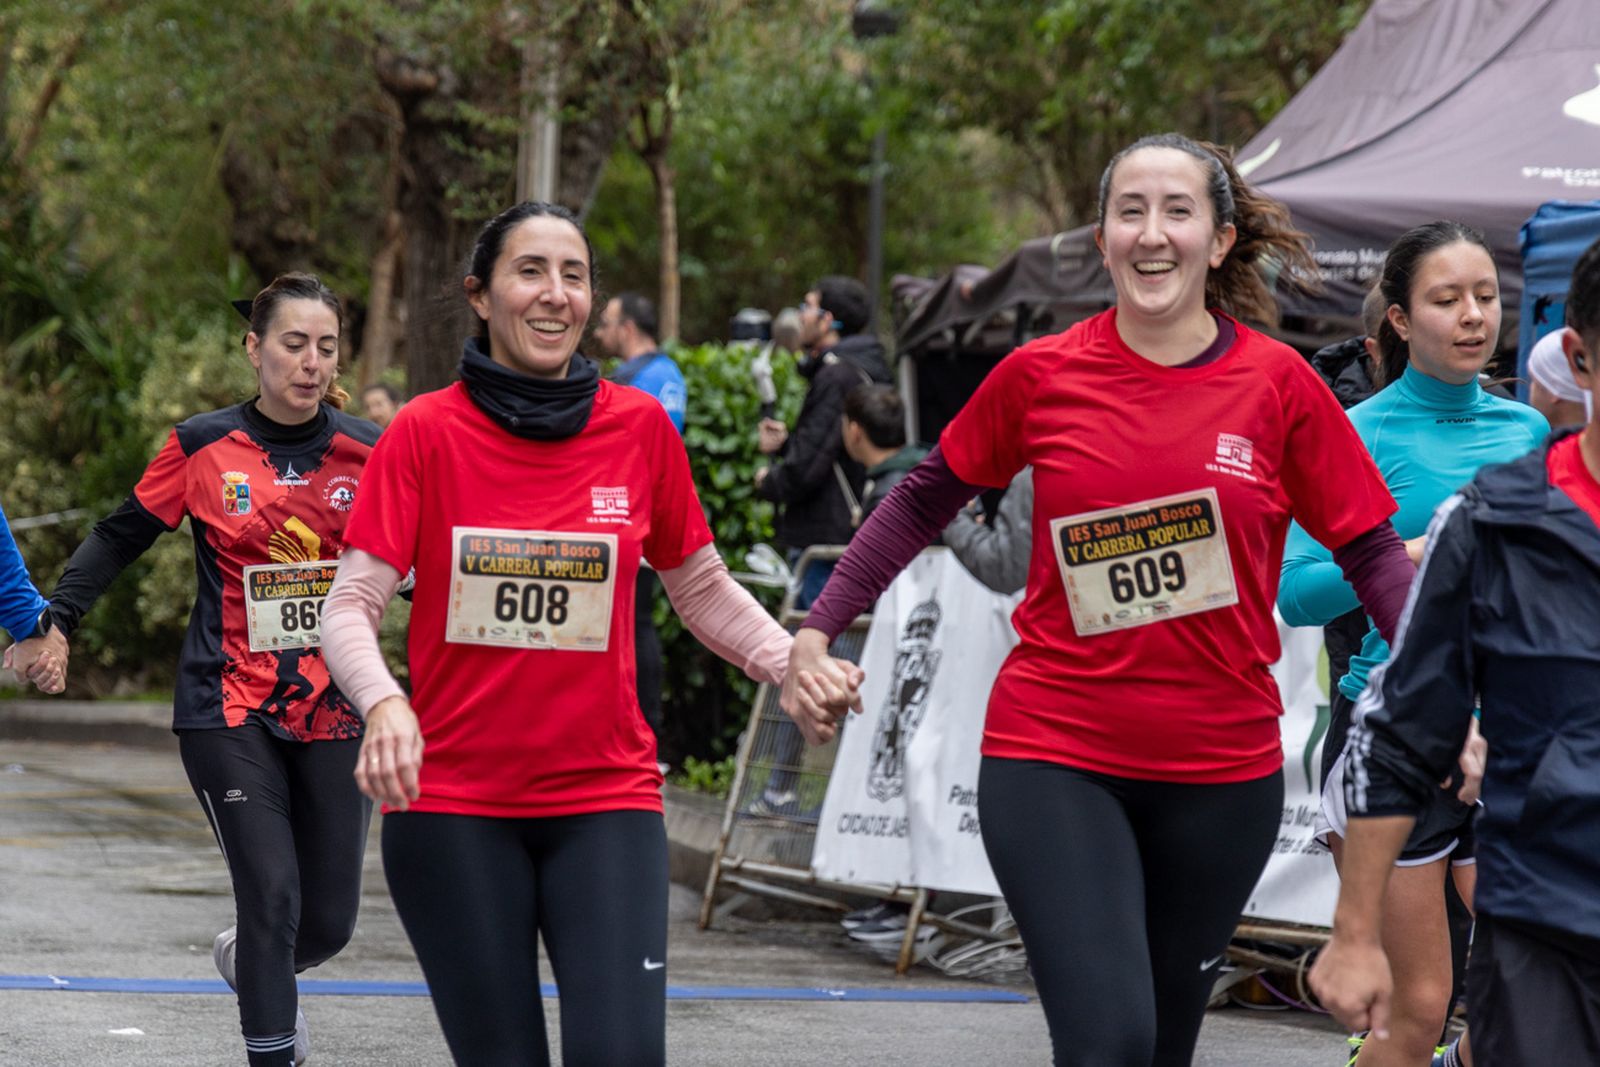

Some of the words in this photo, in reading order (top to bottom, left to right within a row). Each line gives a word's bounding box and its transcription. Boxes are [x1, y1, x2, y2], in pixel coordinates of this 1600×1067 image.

[1313, 250, 1357, 265] ronato
[327, 475, 360, 488] CORRECAM
[1068, 525, 1091, 543] IES
[1094, 521, 1121, 539] San
[1124, 512, 1157, 532] Juan
[1160, 503, 1203, 523] Bosco
[469, 538, 491, 553] IES
[495, 540, 521, 555] San
[524, 541, 557, 557] Juan
[560, 543, 601, 558] Bosco
[1067, 545, 1080, 563] V
[1083, 534, 1146, 561] CARRERA
[1147, 519, 1211, 546] POPULAR
[256, 573, 272, 585] IES
[275, 571, 295, 583] San
[296, 570, 319, 581] Juan
[321, 568, 337, 579] Bos
[465, 555, 476, 571] V
[479, 556, 540, 576] CARRERA
[543, 560, 605, 580] POPULAR
[1107, 550, 1187, 604] 609
[254, 586, 262, 599] V
[264, 583, 310, 598] CARRERA
[494, 581, 570, 626] 608
[948, 784, 978, 807] Patr
